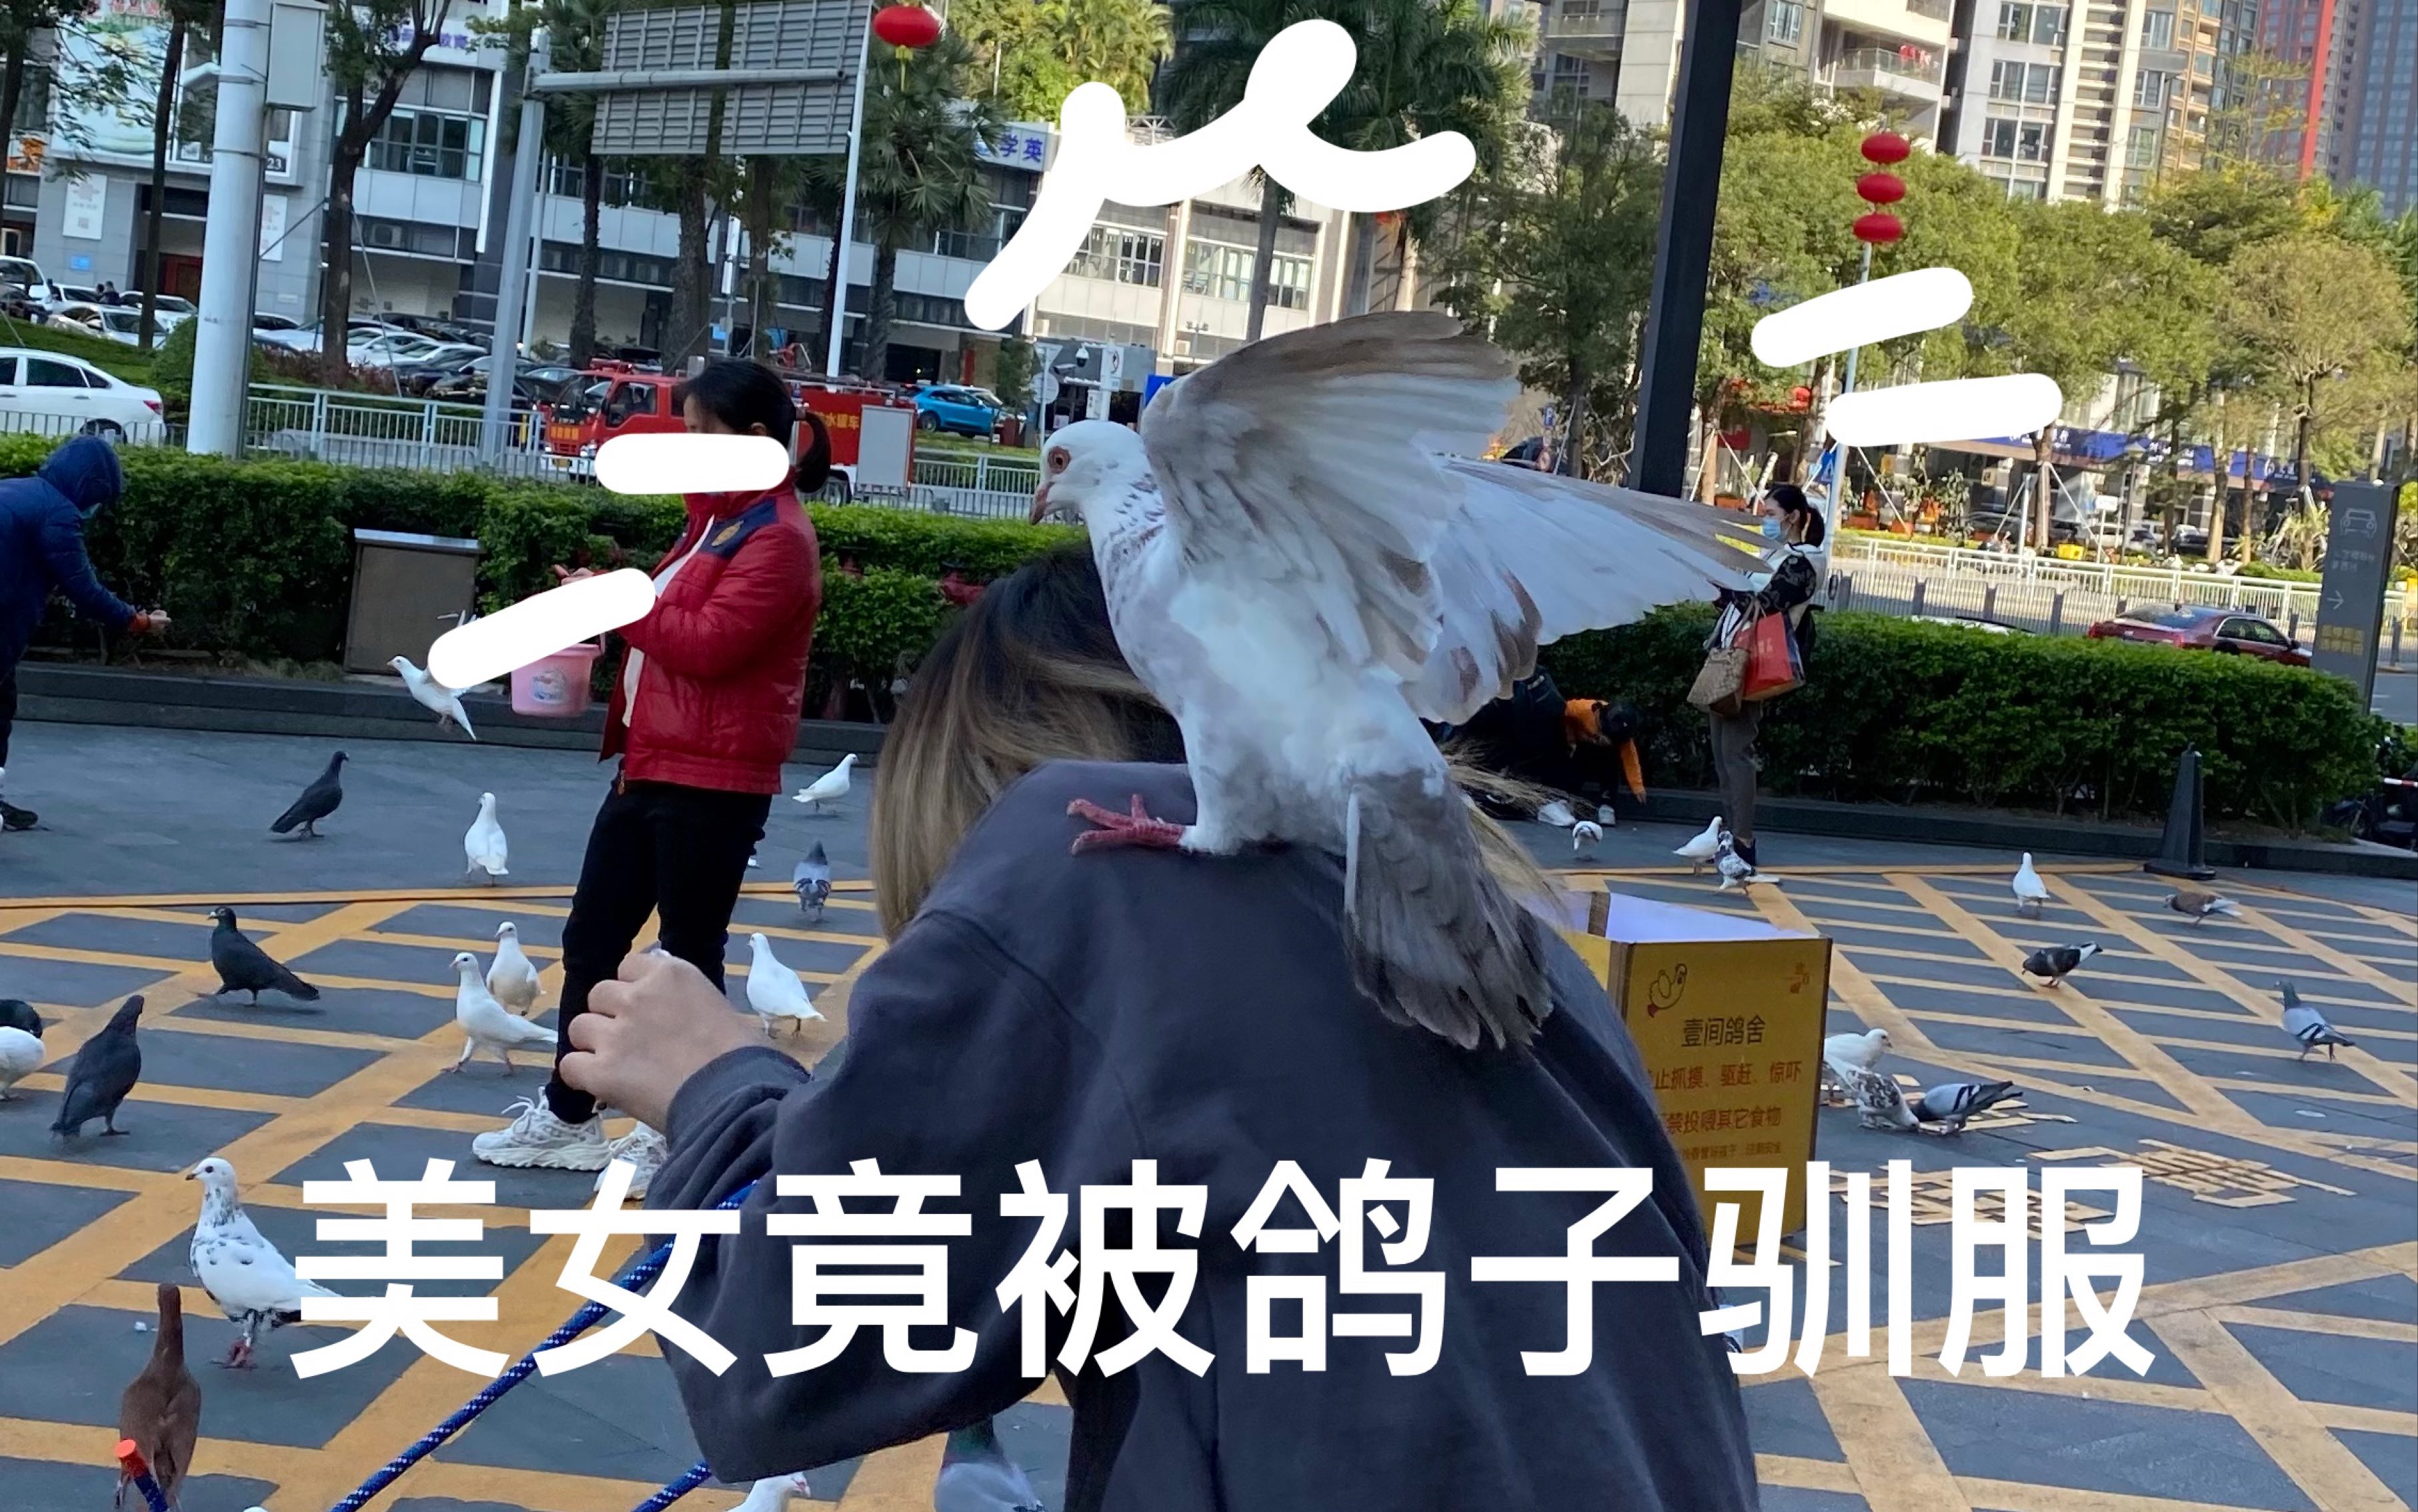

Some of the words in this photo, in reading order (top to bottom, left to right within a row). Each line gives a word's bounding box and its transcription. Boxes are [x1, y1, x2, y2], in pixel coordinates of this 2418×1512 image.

[820, 411, 860, 429] 水罐车
[1681, 1014, 1766, 1048] 壹间鸽舍
[1648, 1060, 1802, 1091] 止抓摸、驱赶、惊吓
[1660, 1104, 1782, 1135] 禁投喂其它食物
